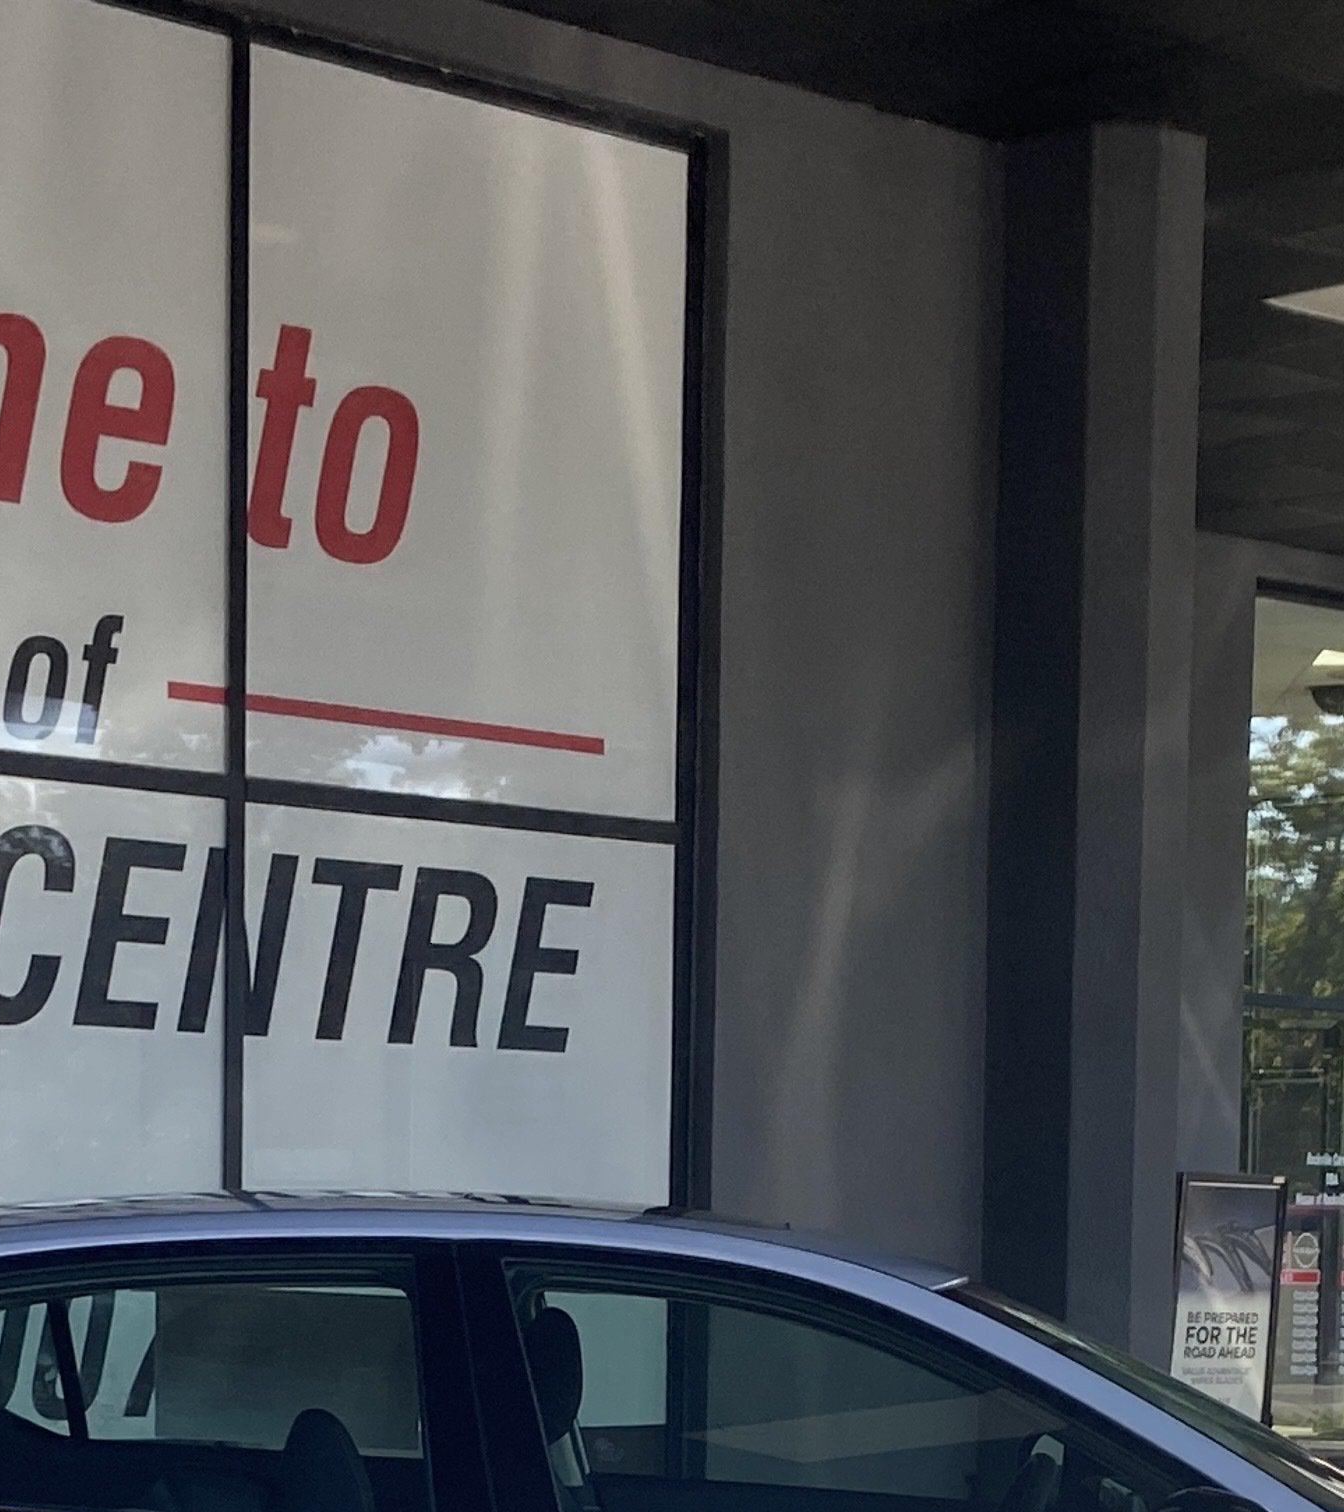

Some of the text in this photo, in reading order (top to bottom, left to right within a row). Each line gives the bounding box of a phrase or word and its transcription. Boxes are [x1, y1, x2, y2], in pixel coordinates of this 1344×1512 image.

[246, 324, 420, 564] to
[2, 614, 124, 745] of
[1187, 1311, 1259, 1324] BE PREPARED
[1185, 1326, 1259, 1344] FOR THE
[1183, 1346, 1257, 1359] ROAD AHEAD
